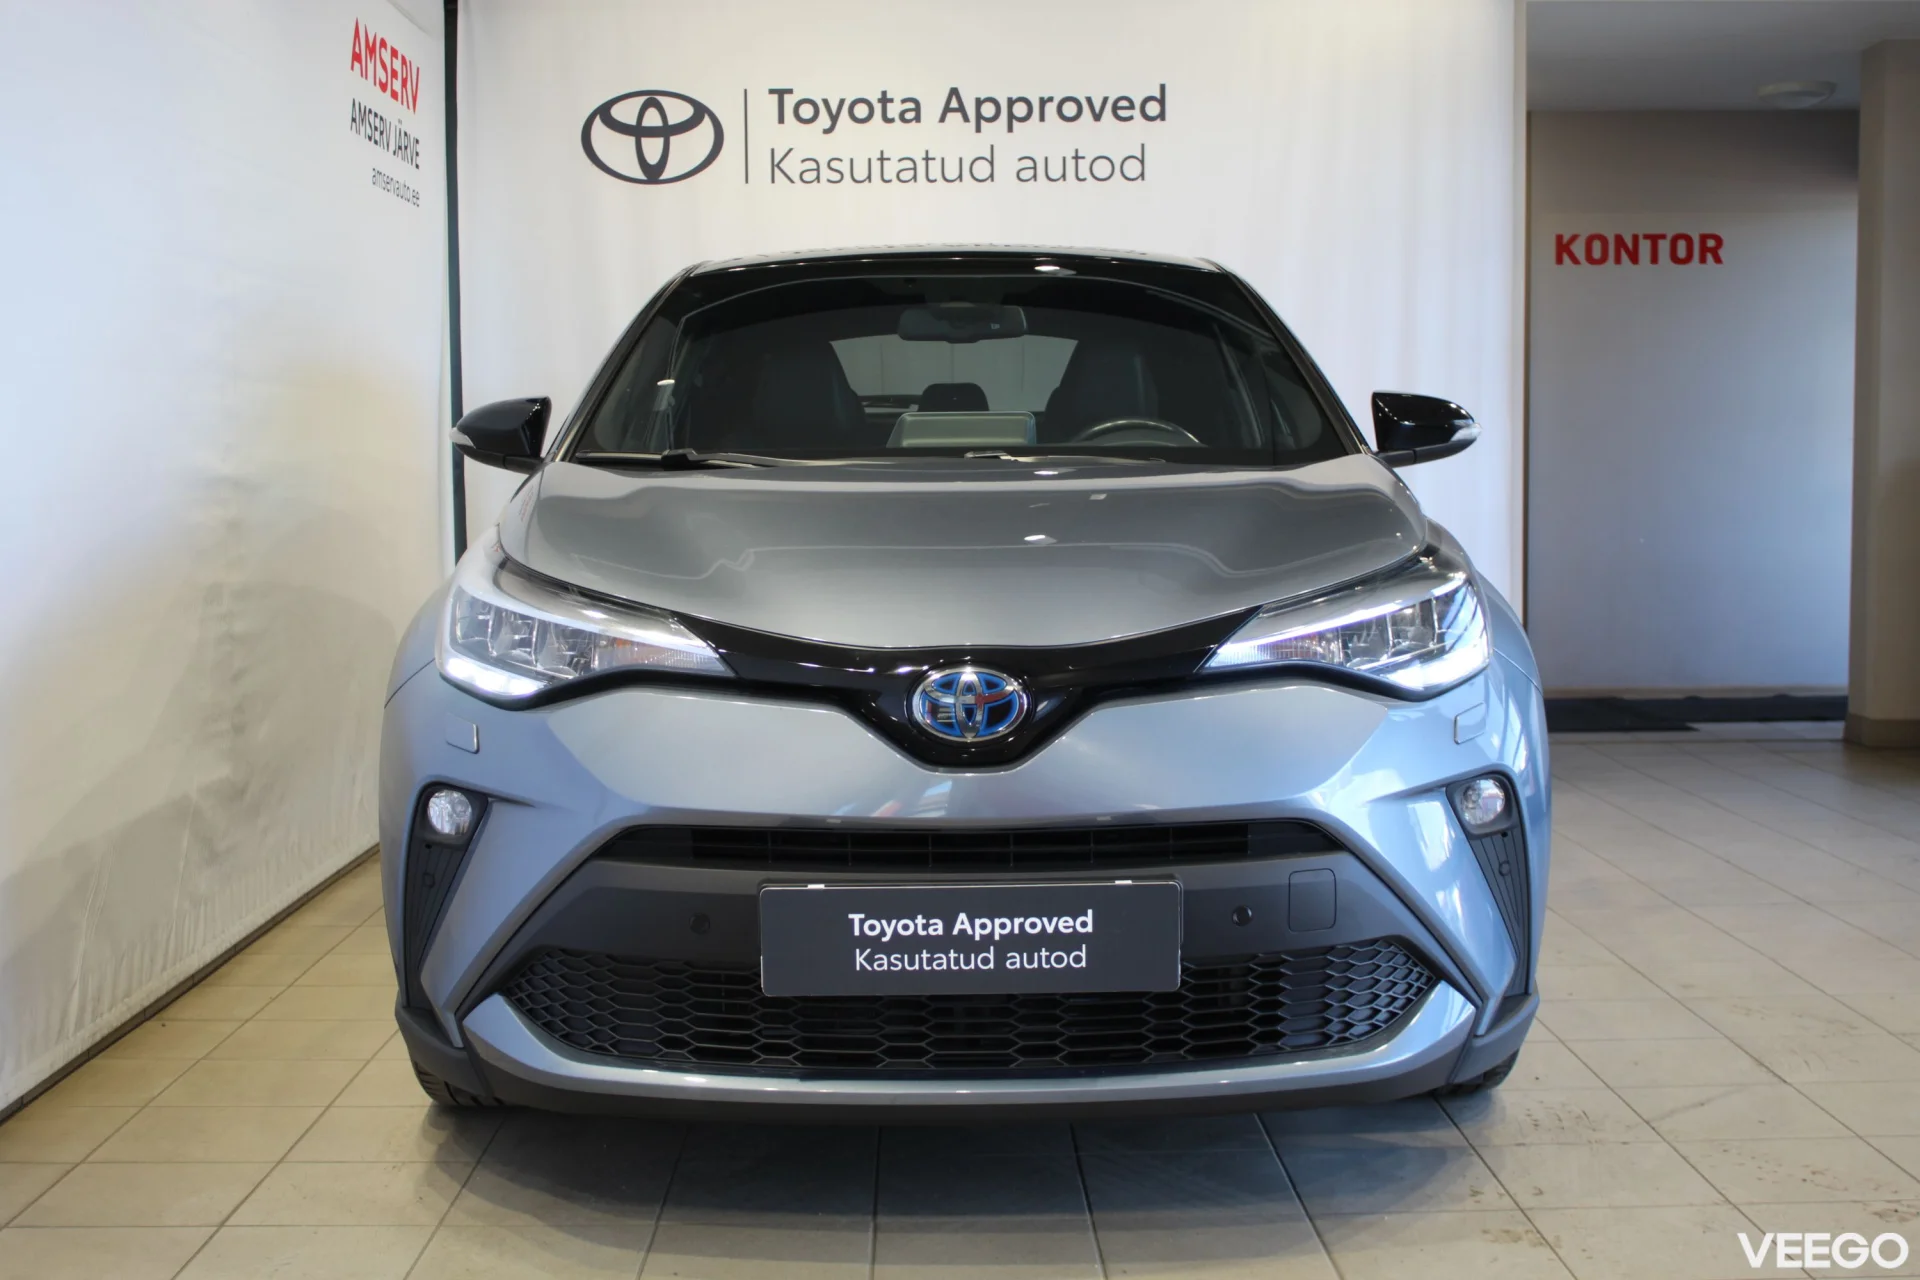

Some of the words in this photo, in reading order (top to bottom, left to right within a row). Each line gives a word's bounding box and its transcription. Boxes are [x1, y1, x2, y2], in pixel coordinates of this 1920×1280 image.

[350, 17, 420, 114] AMSERV
[768, 88, 922, 134] Toyota
[938, 83, 1167, 133] Approved
[350, 98, 391, 152] AMSERV
[392, 118, 420, 169] JÄRVE
[769, 144, 996, 184] Kasutatud
[1015, 143, 1146, 182] autod
[372, 167, 420, 207] amservauto.ee
[1555, 233, 1724, 265] KONTOR
[848, 913, 944, 942] Toyota
[952, 909, 1093, 940] Approved
[855, 946, 994, 971] Kasutatud
[1005, 944, 1087, 969] autod
